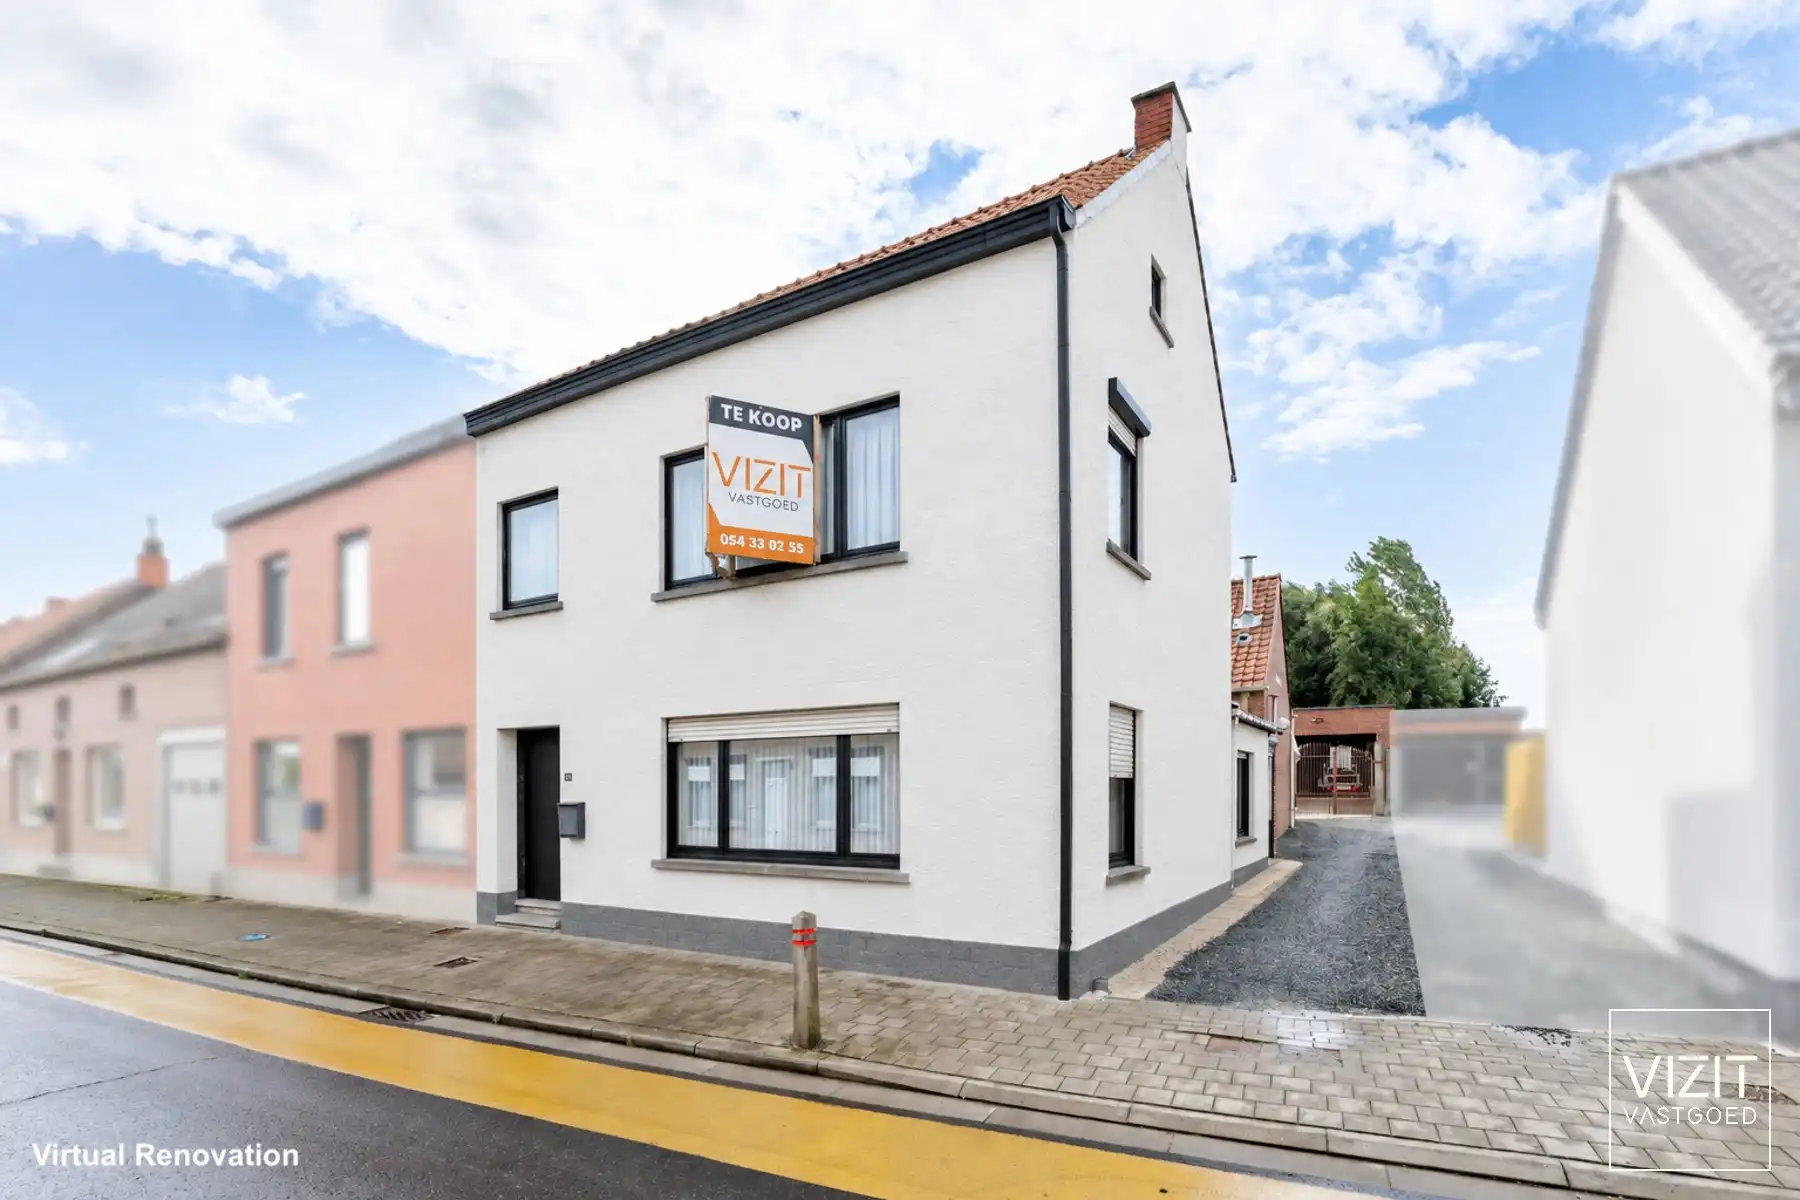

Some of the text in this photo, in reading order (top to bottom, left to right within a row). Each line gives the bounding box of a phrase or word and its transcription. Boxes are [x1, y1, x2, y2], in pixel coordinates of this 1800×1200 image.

[720, 403, 803, 432] TE KOOP
[712, 451, 811, 498] VIZIT
[728, 492, 799, 512] VASTGOED
[720, 533, 804, 554] 054 33 02 55
